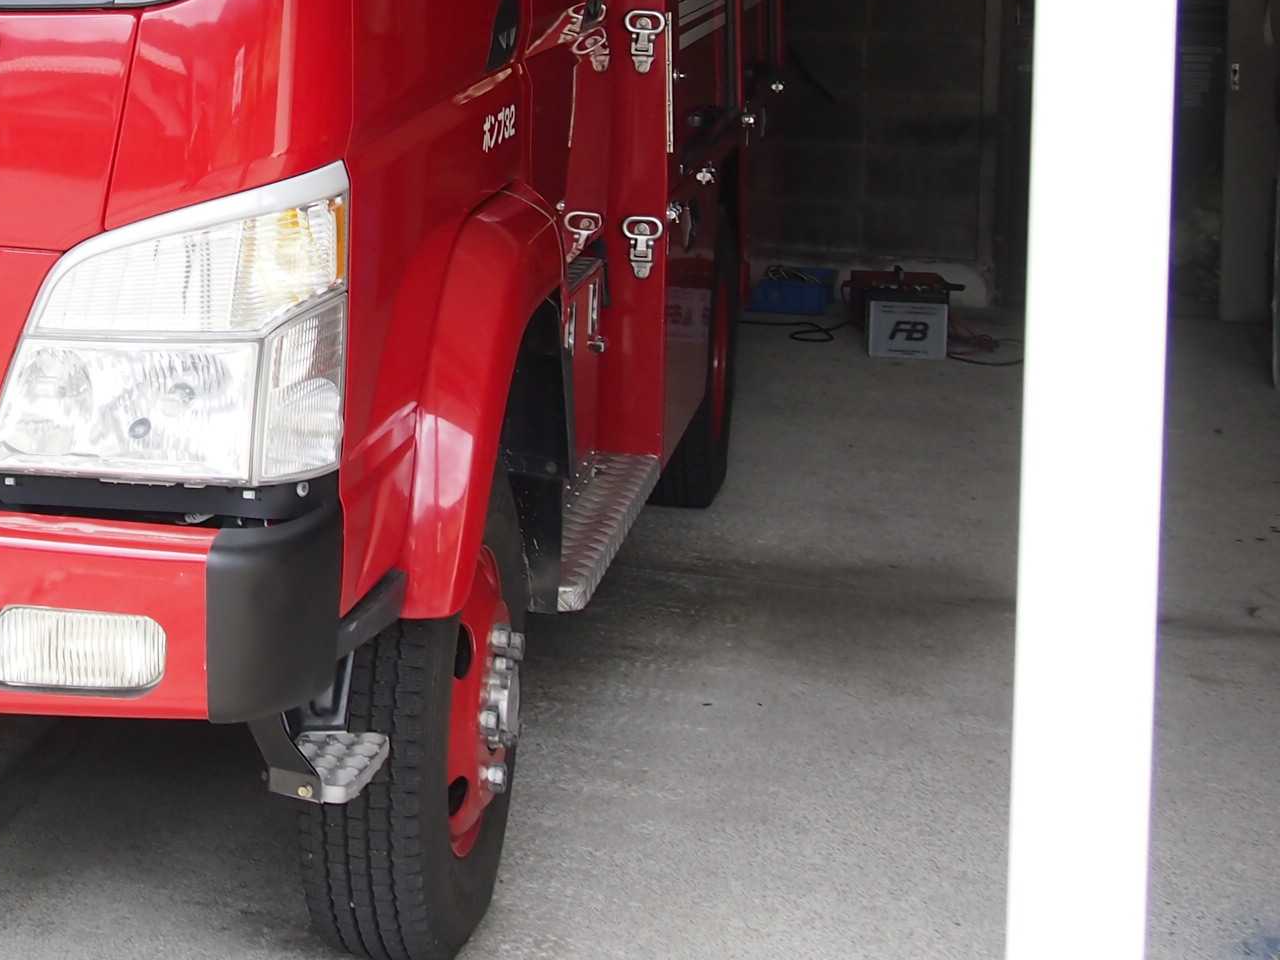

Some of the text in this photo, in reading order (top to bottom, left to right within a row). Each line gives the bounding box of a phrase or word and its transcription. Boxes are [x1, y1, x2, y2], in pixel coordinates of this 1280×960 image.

[482, 103, 516, 153] ポンプ32
[888, 320, 930, 342] FB
